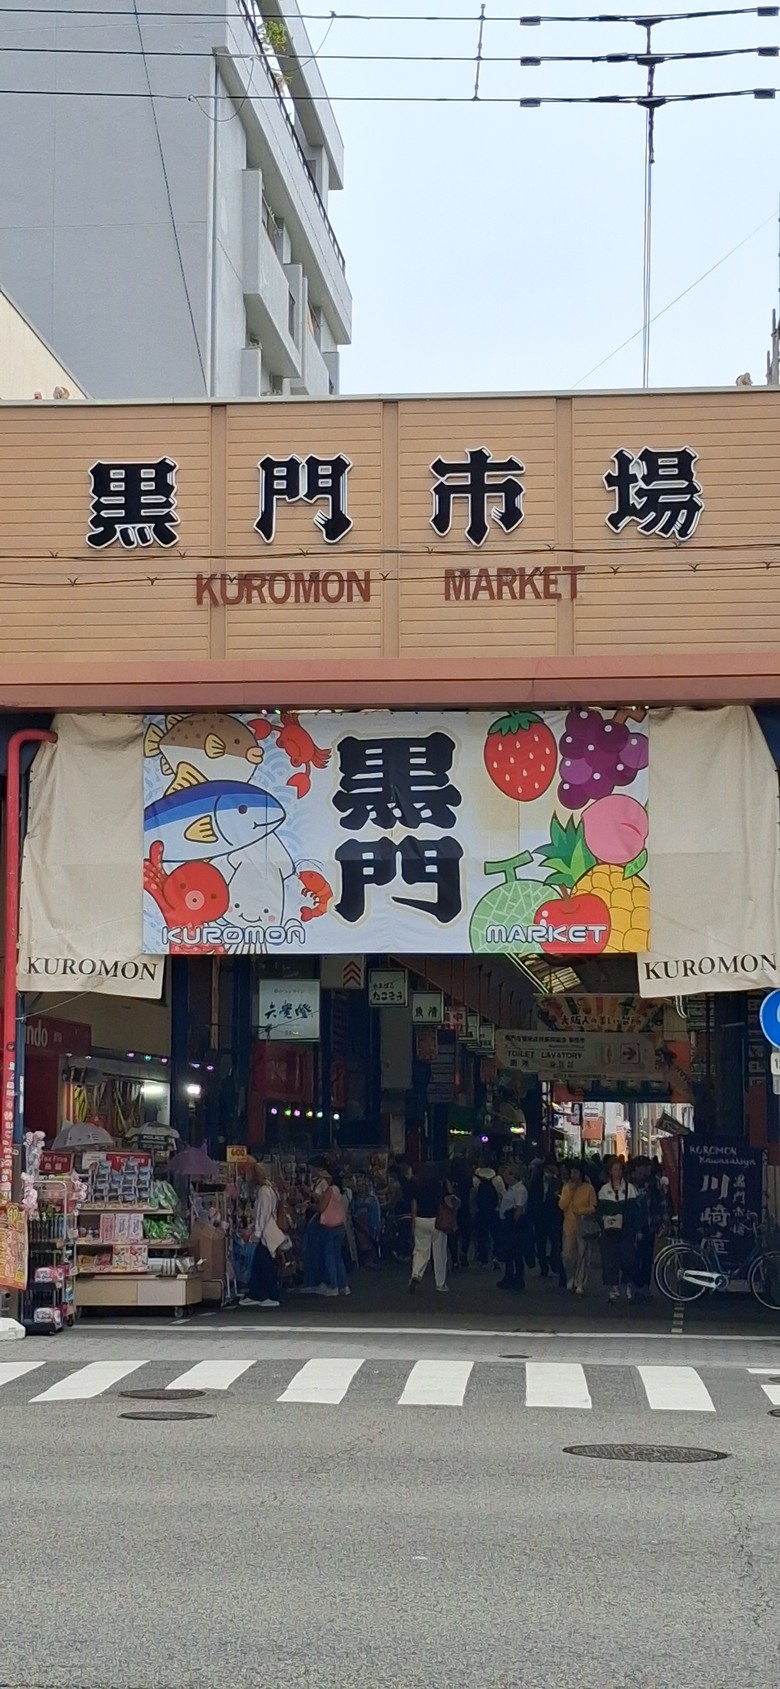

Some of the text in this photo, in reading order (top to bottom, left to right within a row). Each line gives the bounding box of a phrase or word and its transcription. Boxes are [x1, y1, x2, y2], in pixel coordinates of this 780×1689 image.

[86, 445, 705, 550] 黒門市場
[195, 565, 586, 606] KUROMON MARKET
[333, 732, 463, 924] 黒門
[161, 923, 608, 947] KUROMON MARKET
[26, 954, 159, 983] KUROMON
[643, 951, 778, 982] KUROMON
[507, 1050, 582, 1060] TOILET LAVATORY
